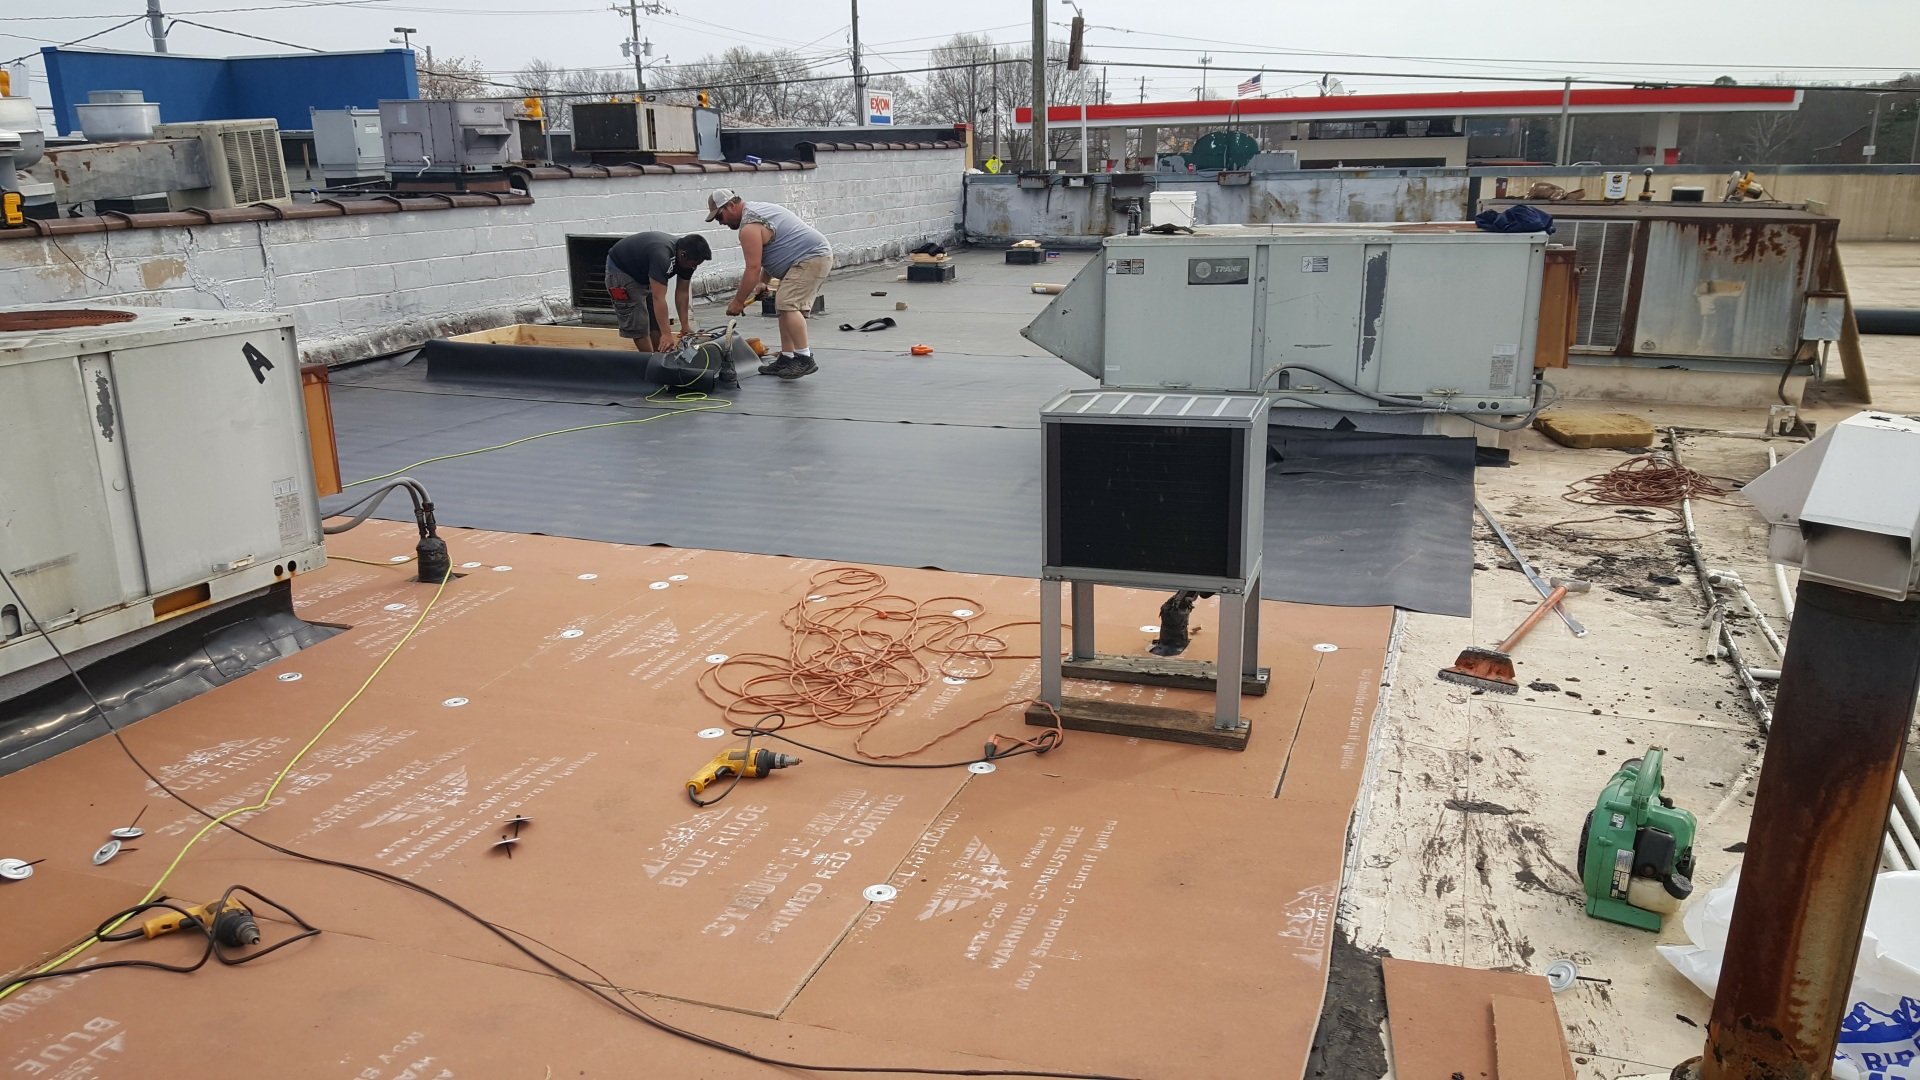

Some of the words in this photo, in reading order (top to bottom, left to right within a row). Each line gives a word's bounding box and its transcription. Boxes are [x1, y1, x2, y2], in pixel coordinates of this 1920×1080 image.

[871, 96, 890, 115] EXXON
[1215, 265, 1242, 273] TRANE
[242, 342, 275, 384] A
[150, 768, 221, 799] BLUE
[222, 736, 292, 769] RIDGE
[387, 816, 472, 868] WARNING:
[430, 820, 494, 861] Smolder
[657, 848, 718, 888] BLUE
[707, 804, 769, 847] RIDGE
[756, 882, 823, 943] PRIMED
[815, 851, 852, 880] RED
[844, 793, 905, 846] COATING
[1020, 839, 1049, 869] R-Value
[1040, 825, 1057, 844] 1.3
[988, 903, 1040, 969] WARNING:
[1028, 825, 1086, 900] COMBUSTIBLE
[1014, 961, 1044, 991] May
[1029, 906, 1070, 959] Smolder
[1083, 848, 1100, 865] if
[13, 1016, 121, 1077] BLUE
